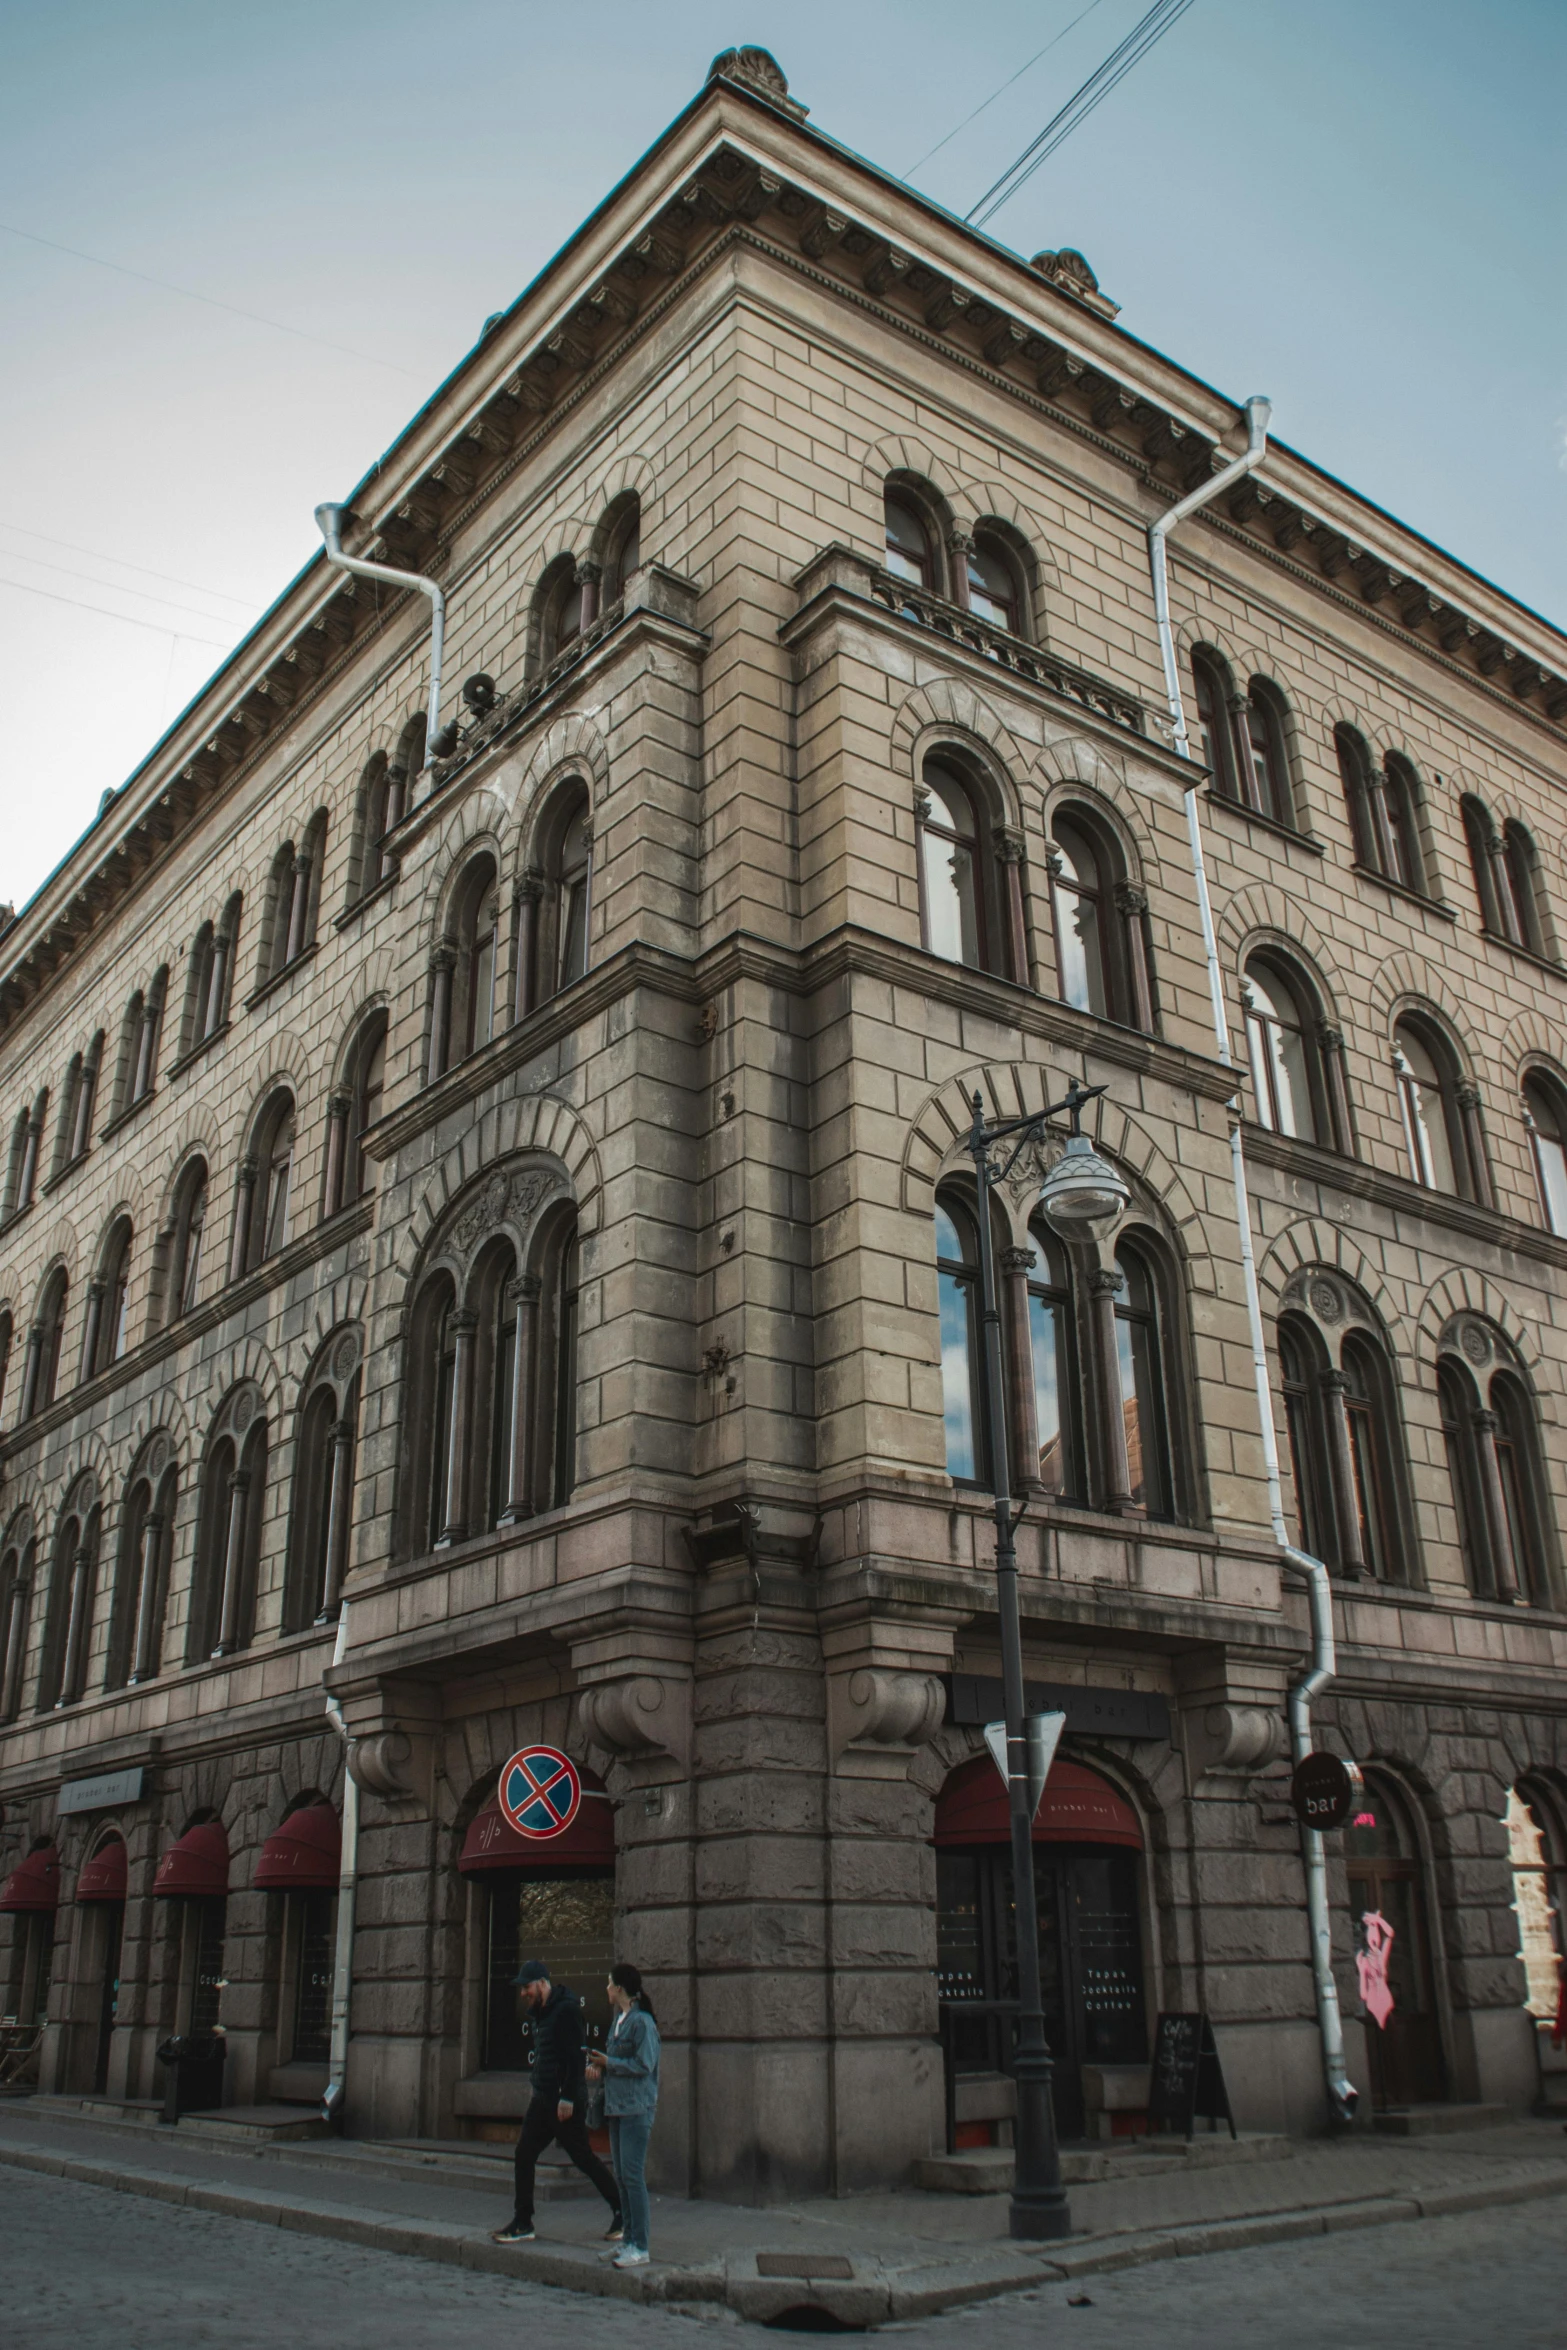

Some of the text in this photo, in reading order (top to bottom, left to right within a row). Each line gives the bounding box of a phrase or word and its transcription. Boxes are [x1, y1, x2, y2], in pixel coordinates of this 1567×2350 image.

[1003, 1697, 1126, 1717] obel bar
[1306, 1796, 1337, 1814] bar
[1087, 1968, 1126, 1980] Tapas
[938, 1987, 984, 1997] cktails
[1085, 2000, 1132, 2011] Coffee
